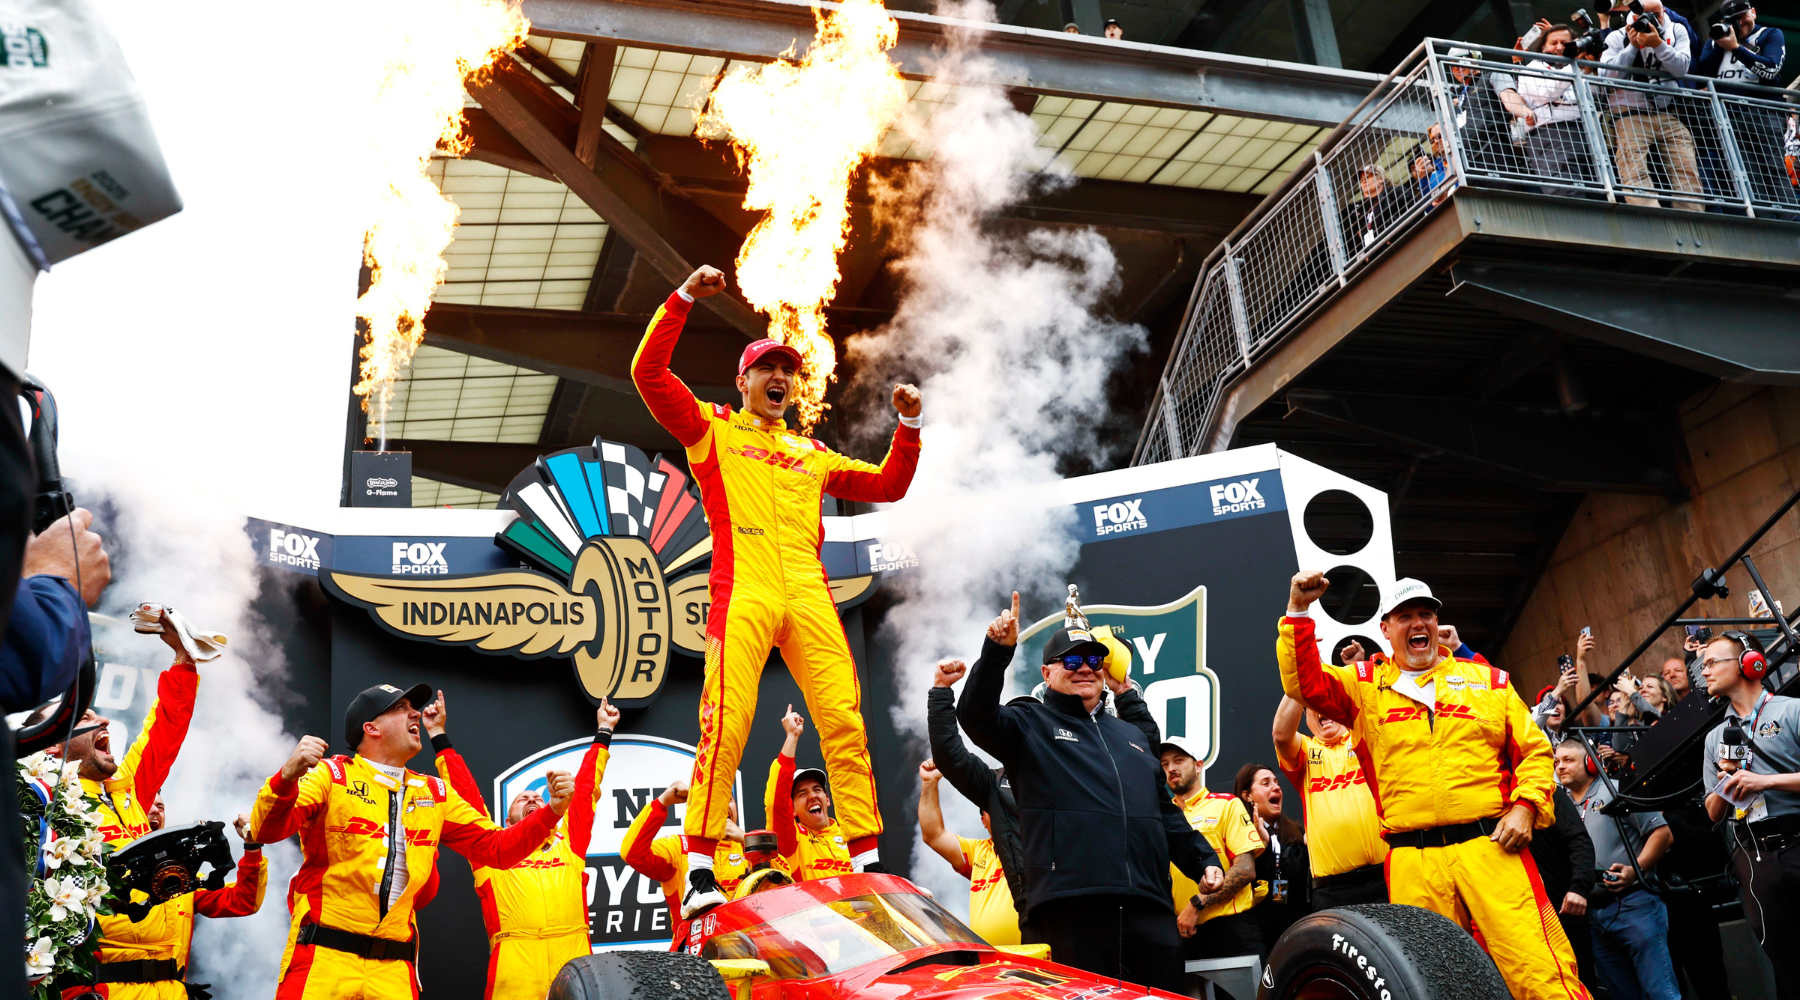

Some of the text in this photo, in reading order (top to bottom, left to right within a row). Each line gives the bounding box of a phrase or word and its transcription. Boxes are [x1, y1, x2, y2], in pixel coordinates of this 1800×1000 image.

[734, 424, 757, 433] HON
[741, 445, 809, 475] DHL
[1209, 478, 1264, 508] FOX
[1093, 499, 1146, 527] FOX
[1213, 499, 1266, 516] SPORTS
[1096, 519, 1148, 536] SPORTS
[270, 528, 320, 560] FOX
[392, 542, 448, 565] FOX
[869, 539, 917, 566] FOX
[269, 552, 320, 570] SPORTS
[391, 564, 448, 574] SPORTS
[870, 558, 919, 573] SPORTS
[401, 601, 585, 626] INDIANAPOLIS
[623, 557, 662, 683] MOTOR
[346, 788, 377, 805] HONDA
[812, 858, 854, 873] DH
[588, 907, 668, 935] ERIE
